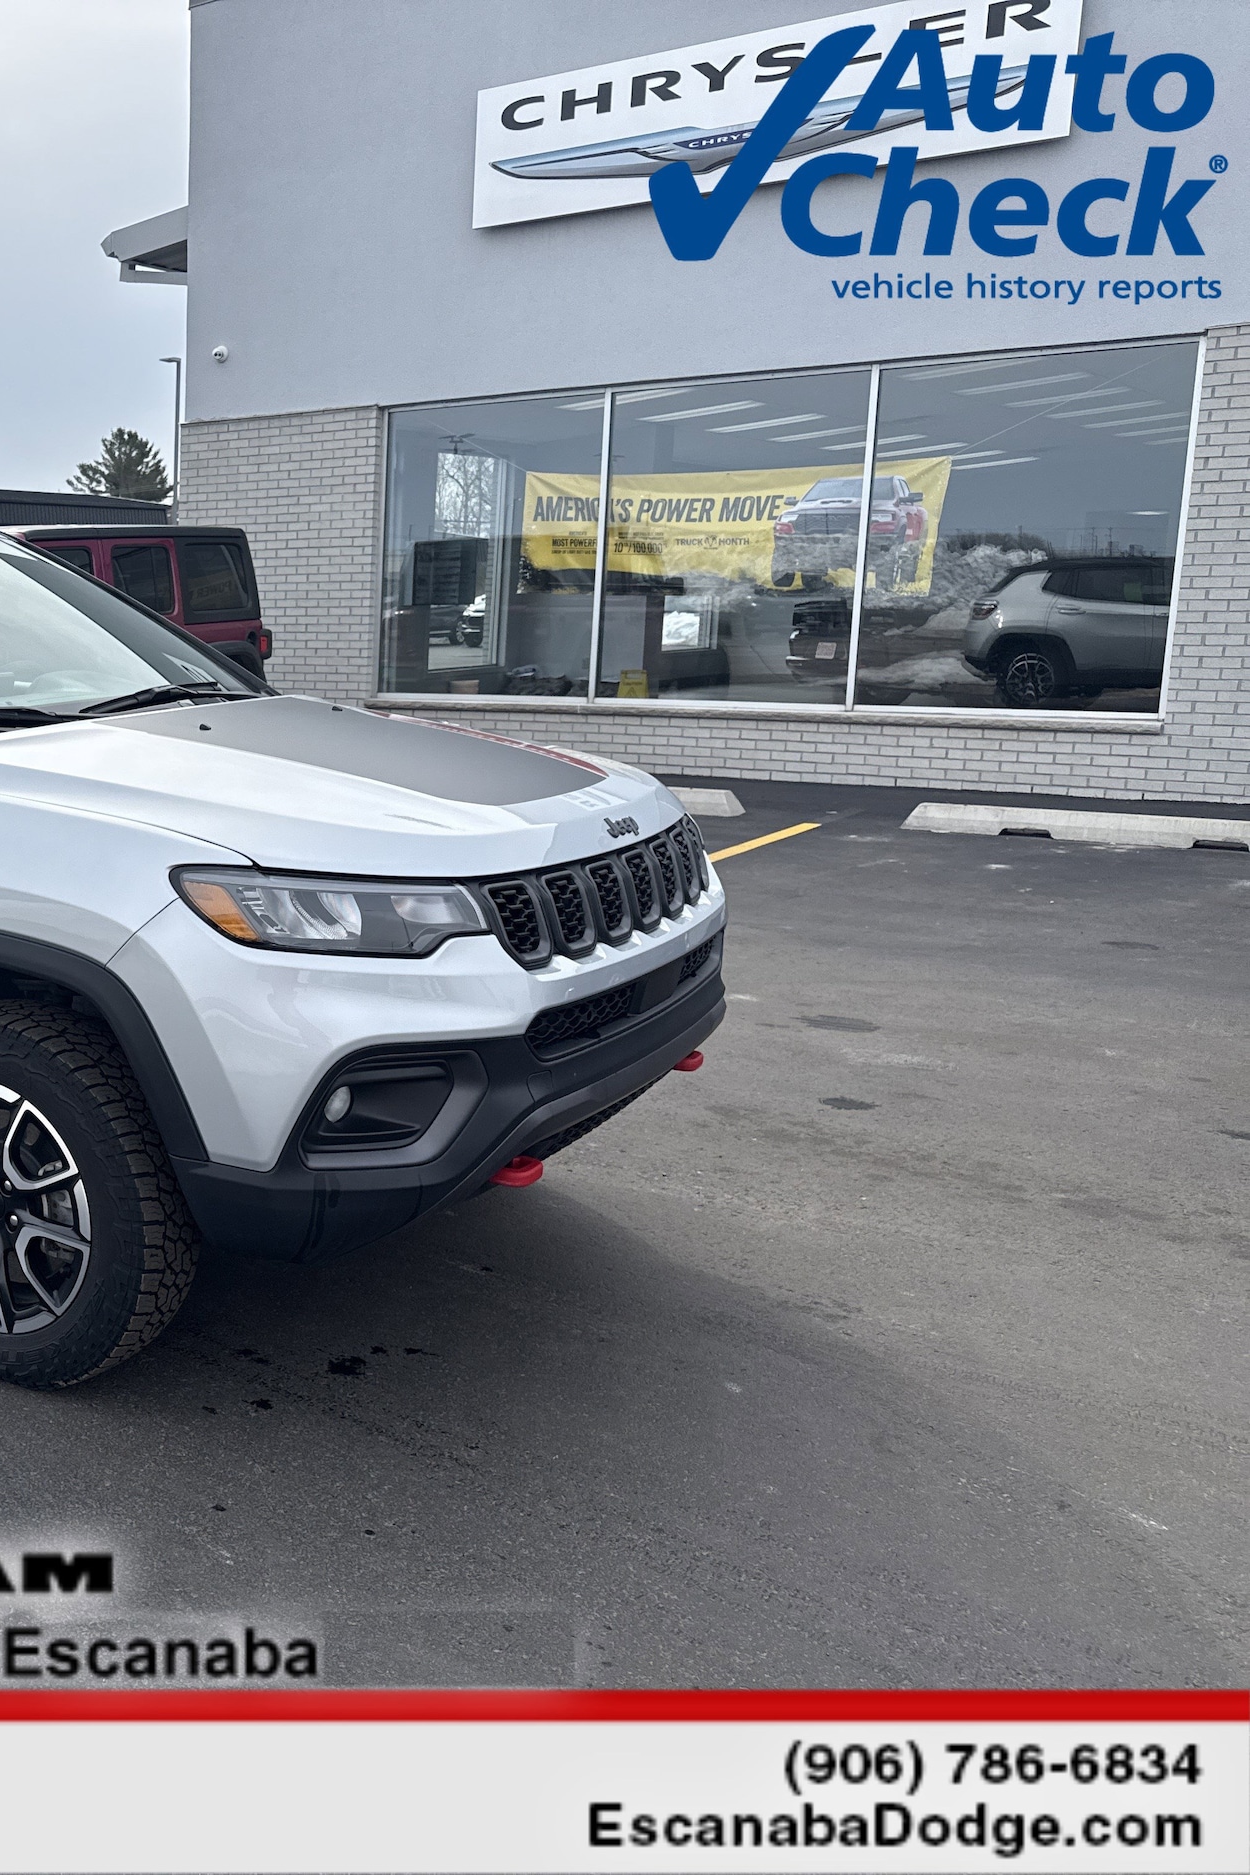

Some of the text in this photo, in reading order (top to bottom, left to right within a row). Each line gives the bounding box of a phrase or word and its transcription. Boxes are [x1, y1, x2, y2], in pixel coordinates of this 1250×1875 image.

[688, 132, 750, 148] CHRYS
[636, 498, 715, 522] POWER
[718, 494, 784, 522] MOVE
[552, 538, 597, 547] MOST POWERF
[675, 538, 703, 546] TRUCK
[603, 816, 640, 838] Jeep
